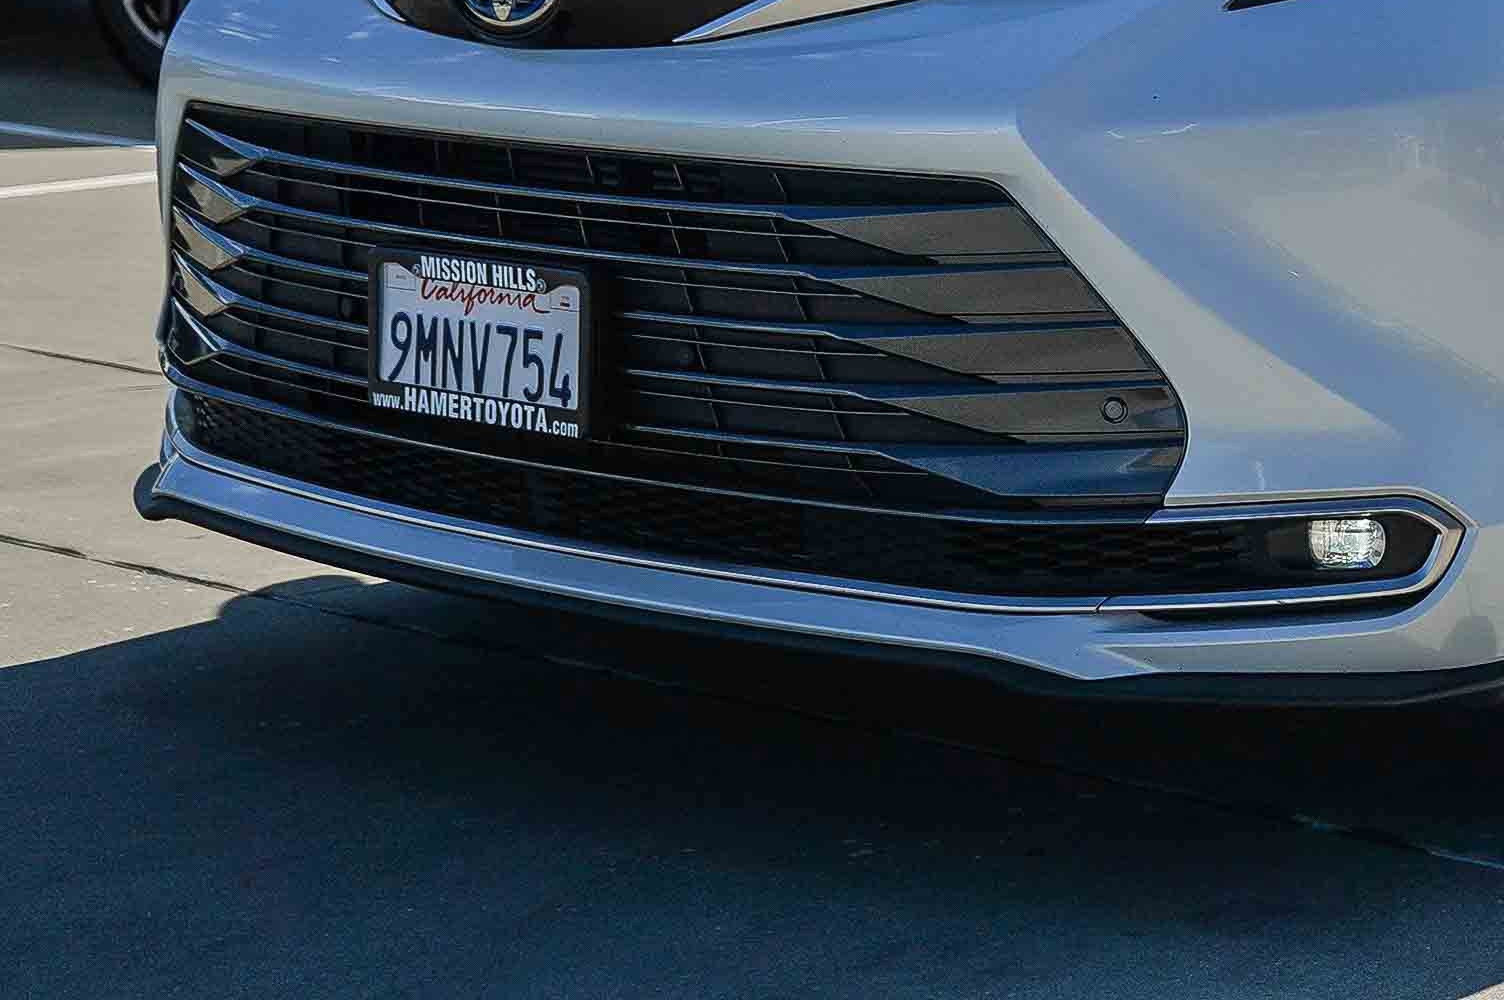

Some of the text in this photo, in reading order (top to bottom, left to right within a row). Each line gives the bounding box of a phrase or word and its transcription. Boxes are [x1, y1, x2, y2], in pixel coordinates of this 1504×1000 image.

[420, 255, 537, 292] MISSION HILLS
[419, 279, 551, 316] California
[388, 311, 572, 408] 9MNV754
[372, 386, 579, 439] www.HAMERTOYOTA.com
